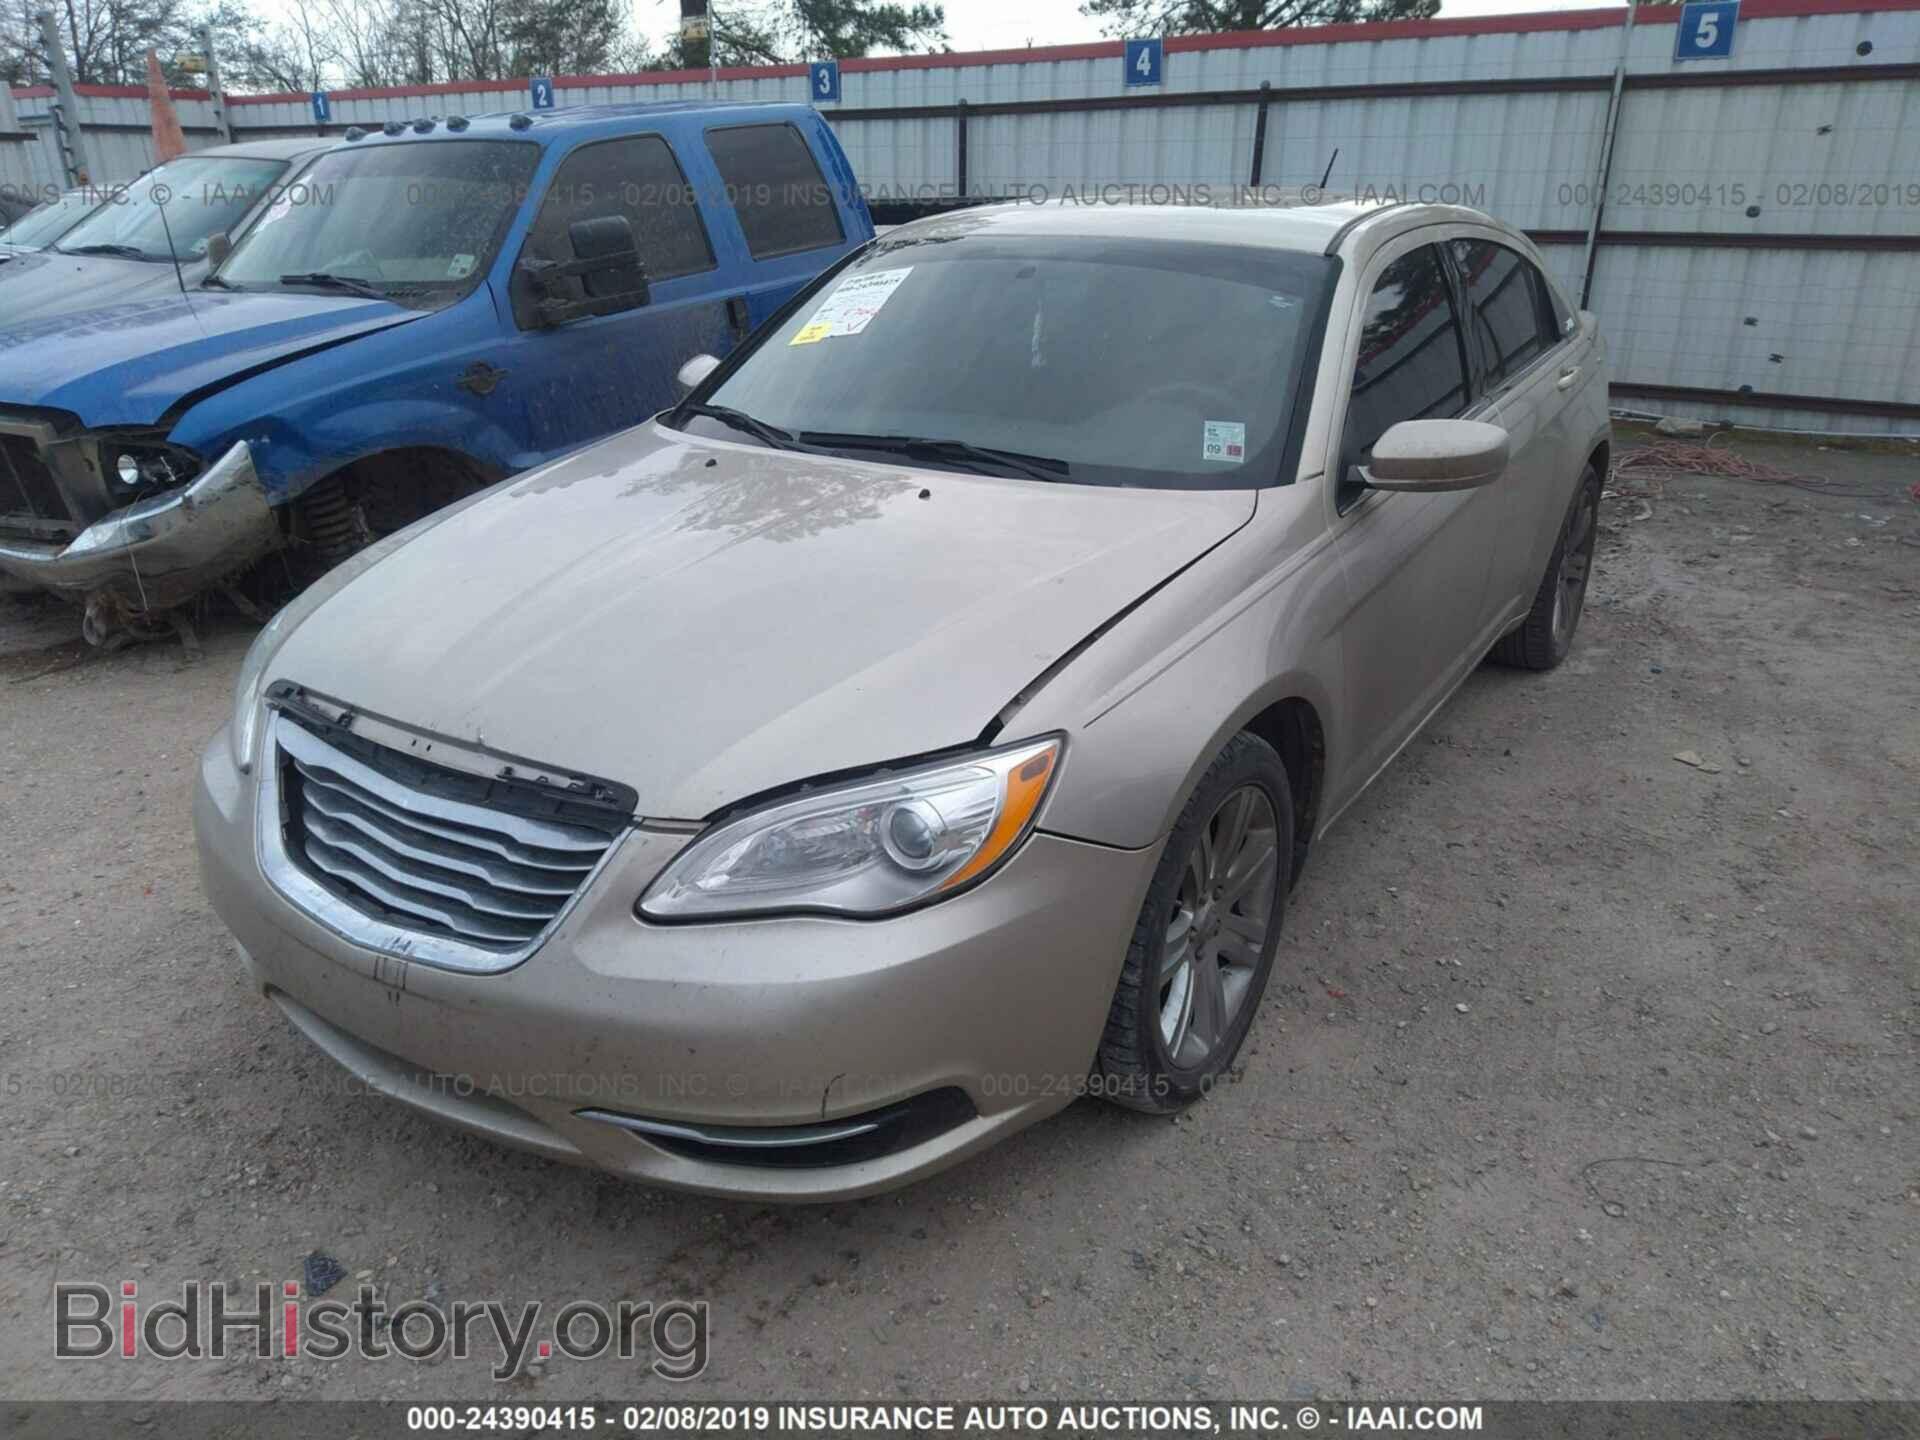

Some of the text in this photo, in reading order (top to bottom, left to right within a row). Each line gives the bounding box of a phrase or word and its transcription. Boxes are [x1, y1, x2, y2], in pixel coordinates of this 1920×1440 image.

[1695, 12, 1719, 48] 5
[1136, 47, 1152, 76] 4
[819, 68, 831, 94] 3
[317, 97, 325, 116] 1
[537, 84, 548, 106] 2
